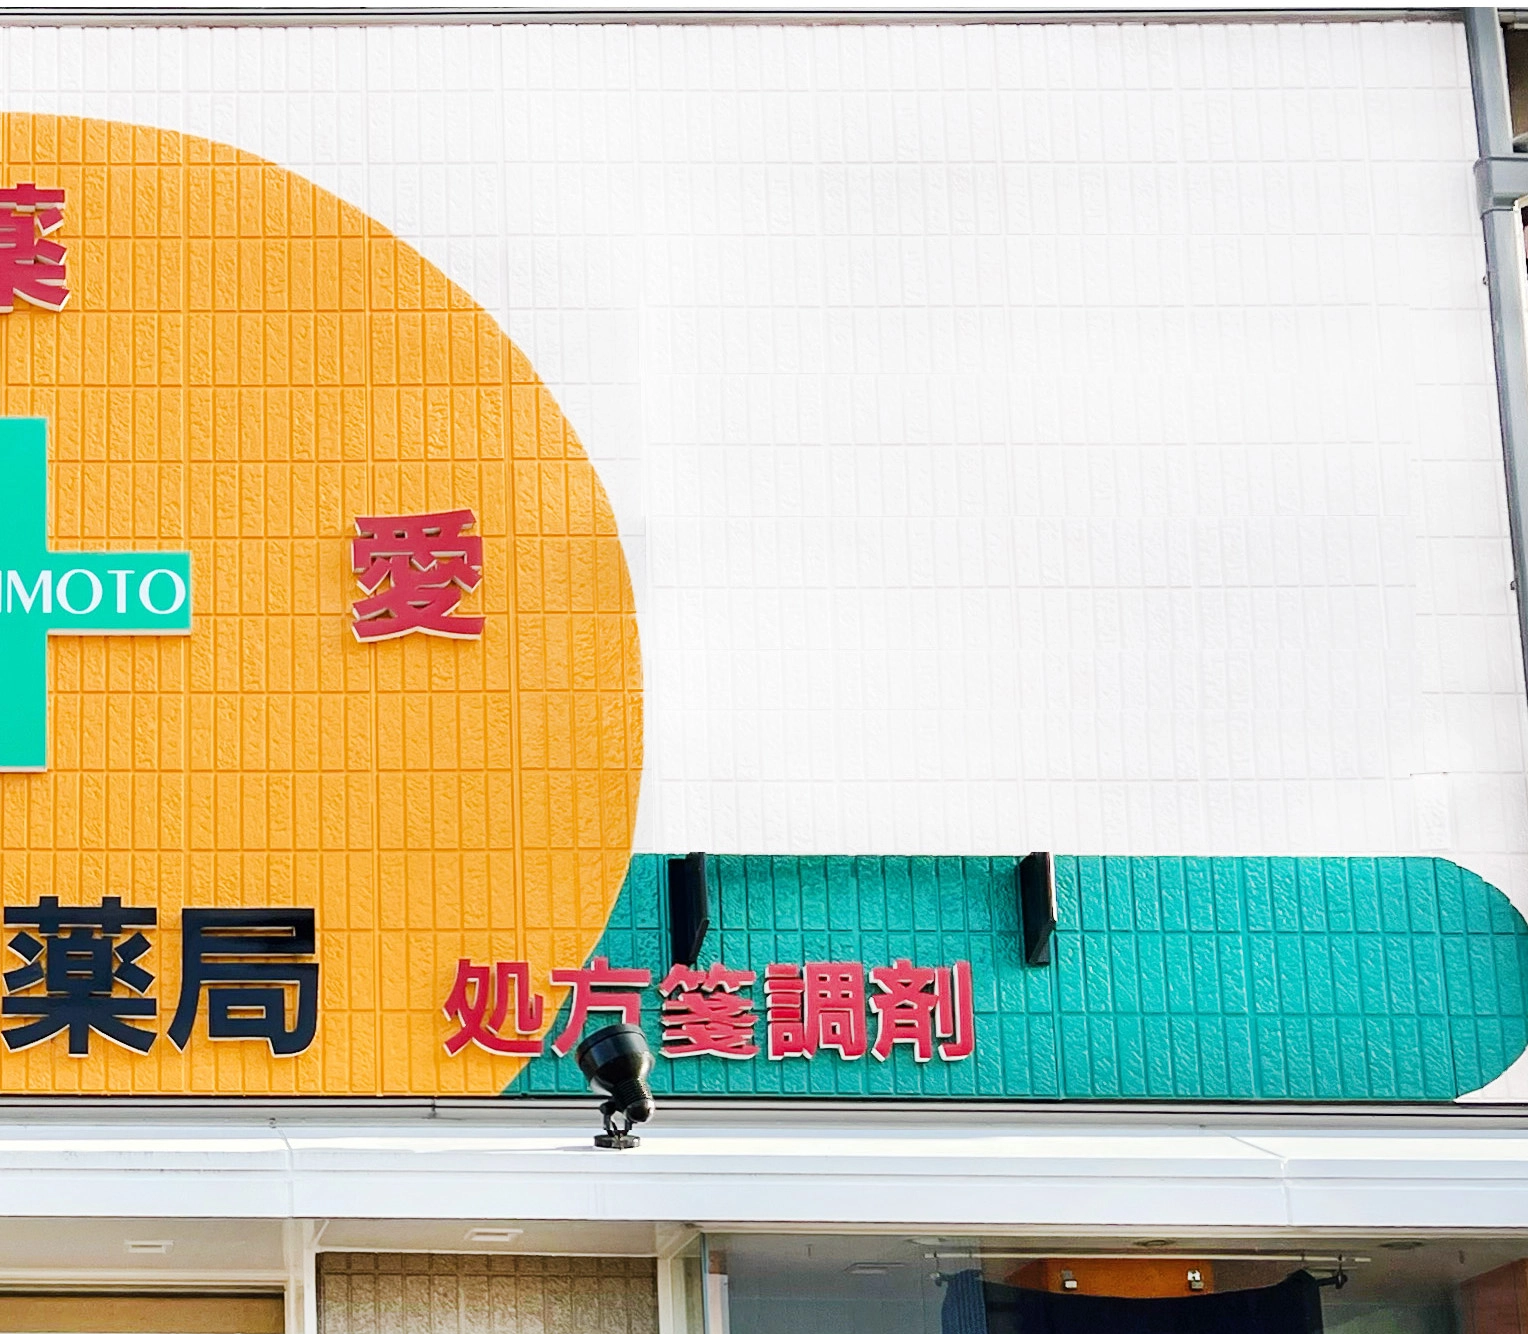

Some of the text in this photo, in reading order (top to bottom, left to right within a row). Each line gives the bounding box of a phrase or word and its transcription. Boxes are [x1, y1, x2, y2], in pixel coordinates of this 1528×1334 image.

[351, 509, 486, 643] 愛
[443, 957, 975, 1063] 処方箋調剤
